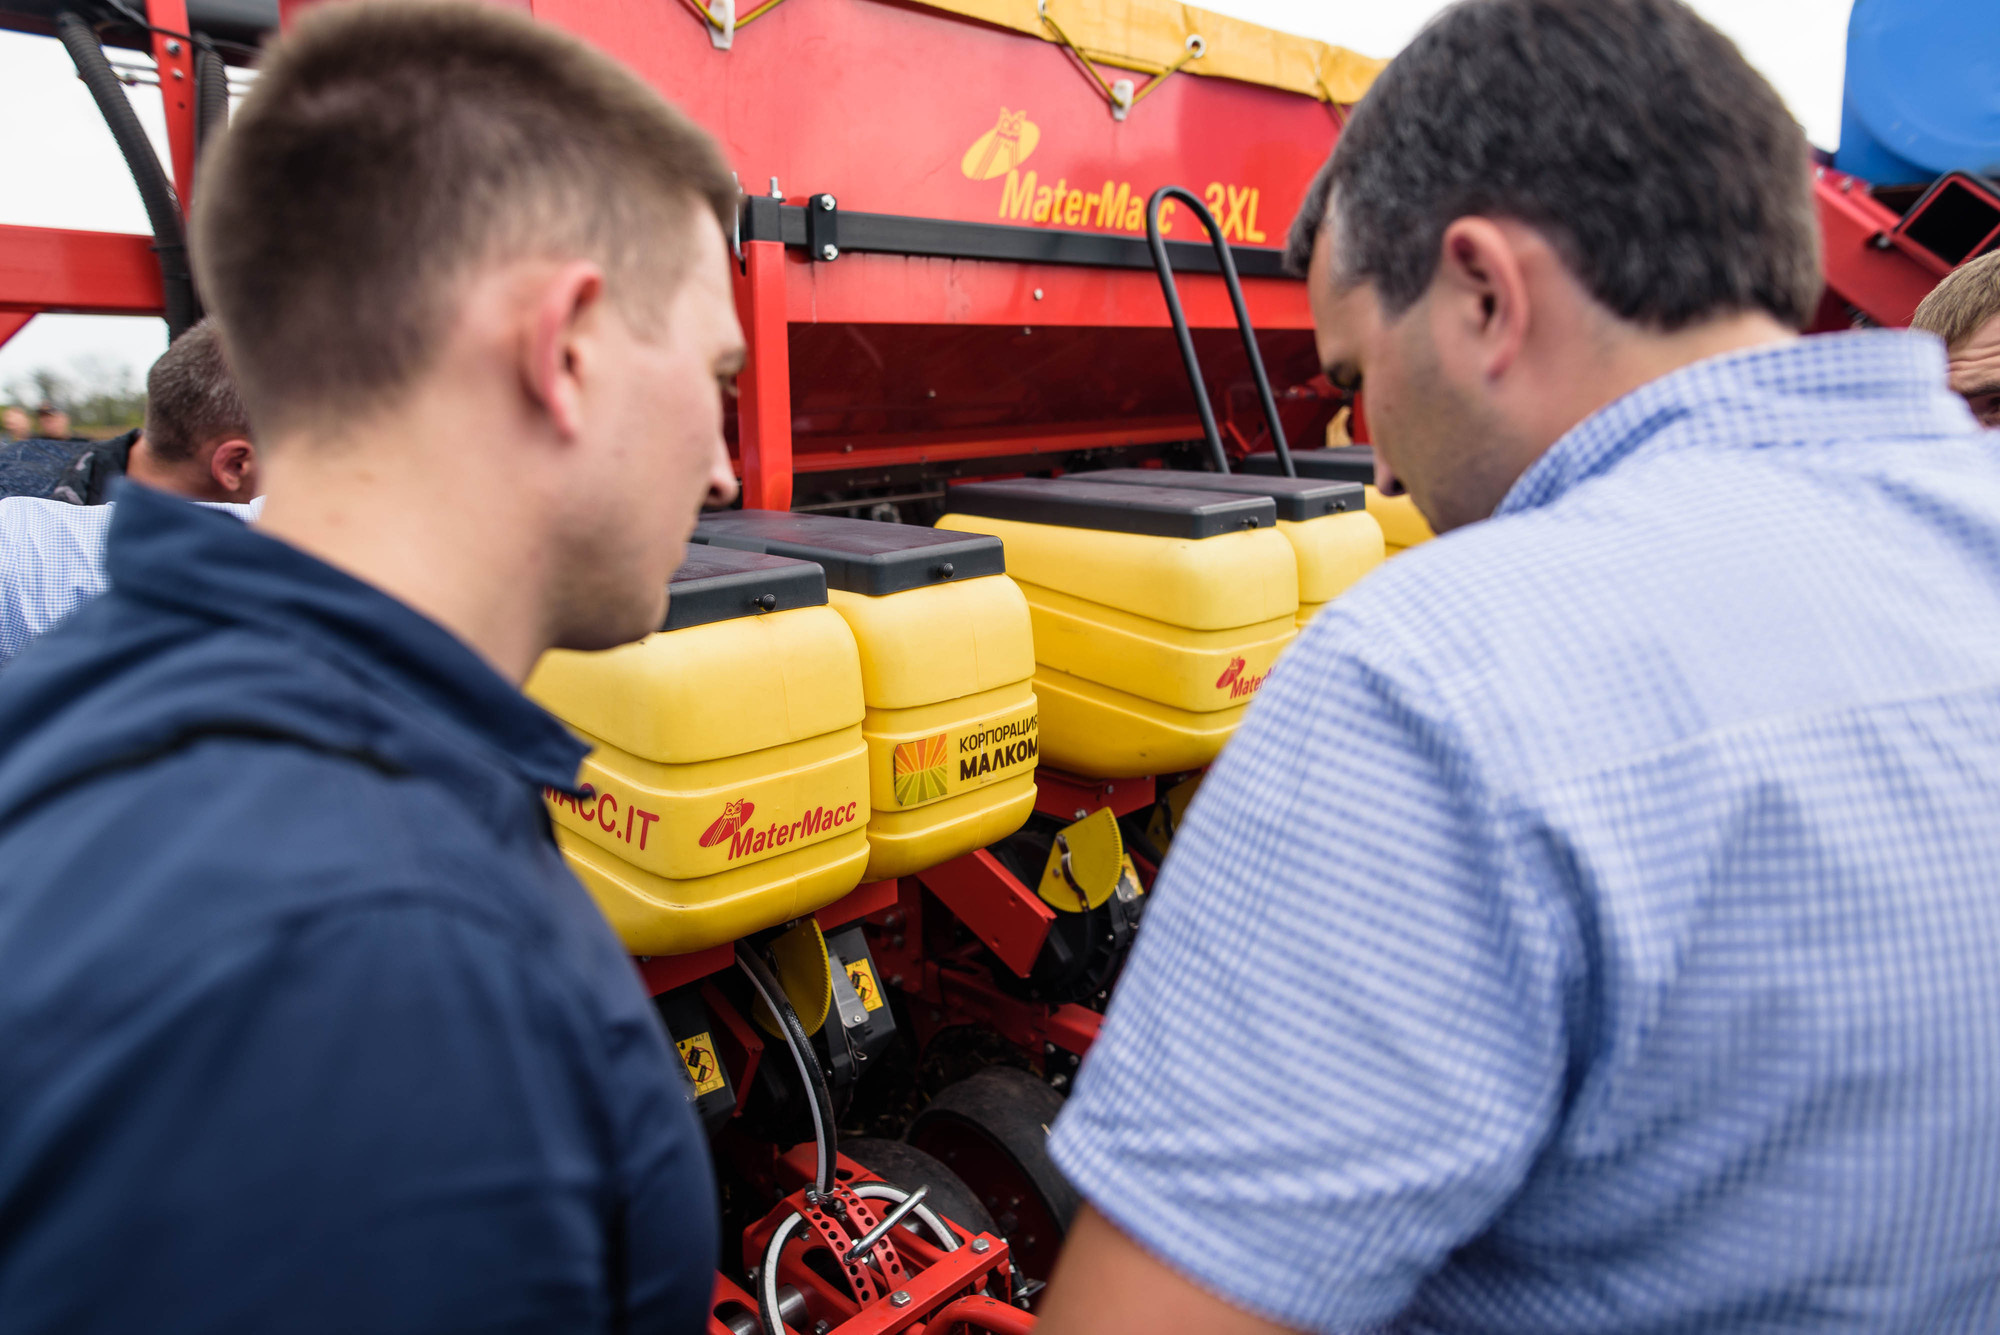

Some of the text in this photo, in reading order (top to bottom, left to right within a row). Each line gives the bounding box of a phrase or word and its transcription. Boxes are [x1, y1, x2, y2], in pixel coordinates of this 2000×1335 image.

[999, 168, 1267, 243] MaterMac 3XL
[960, 735, 1037, 781] МАЛКОМ
[728, 801, 857, 861] MaterMacc
